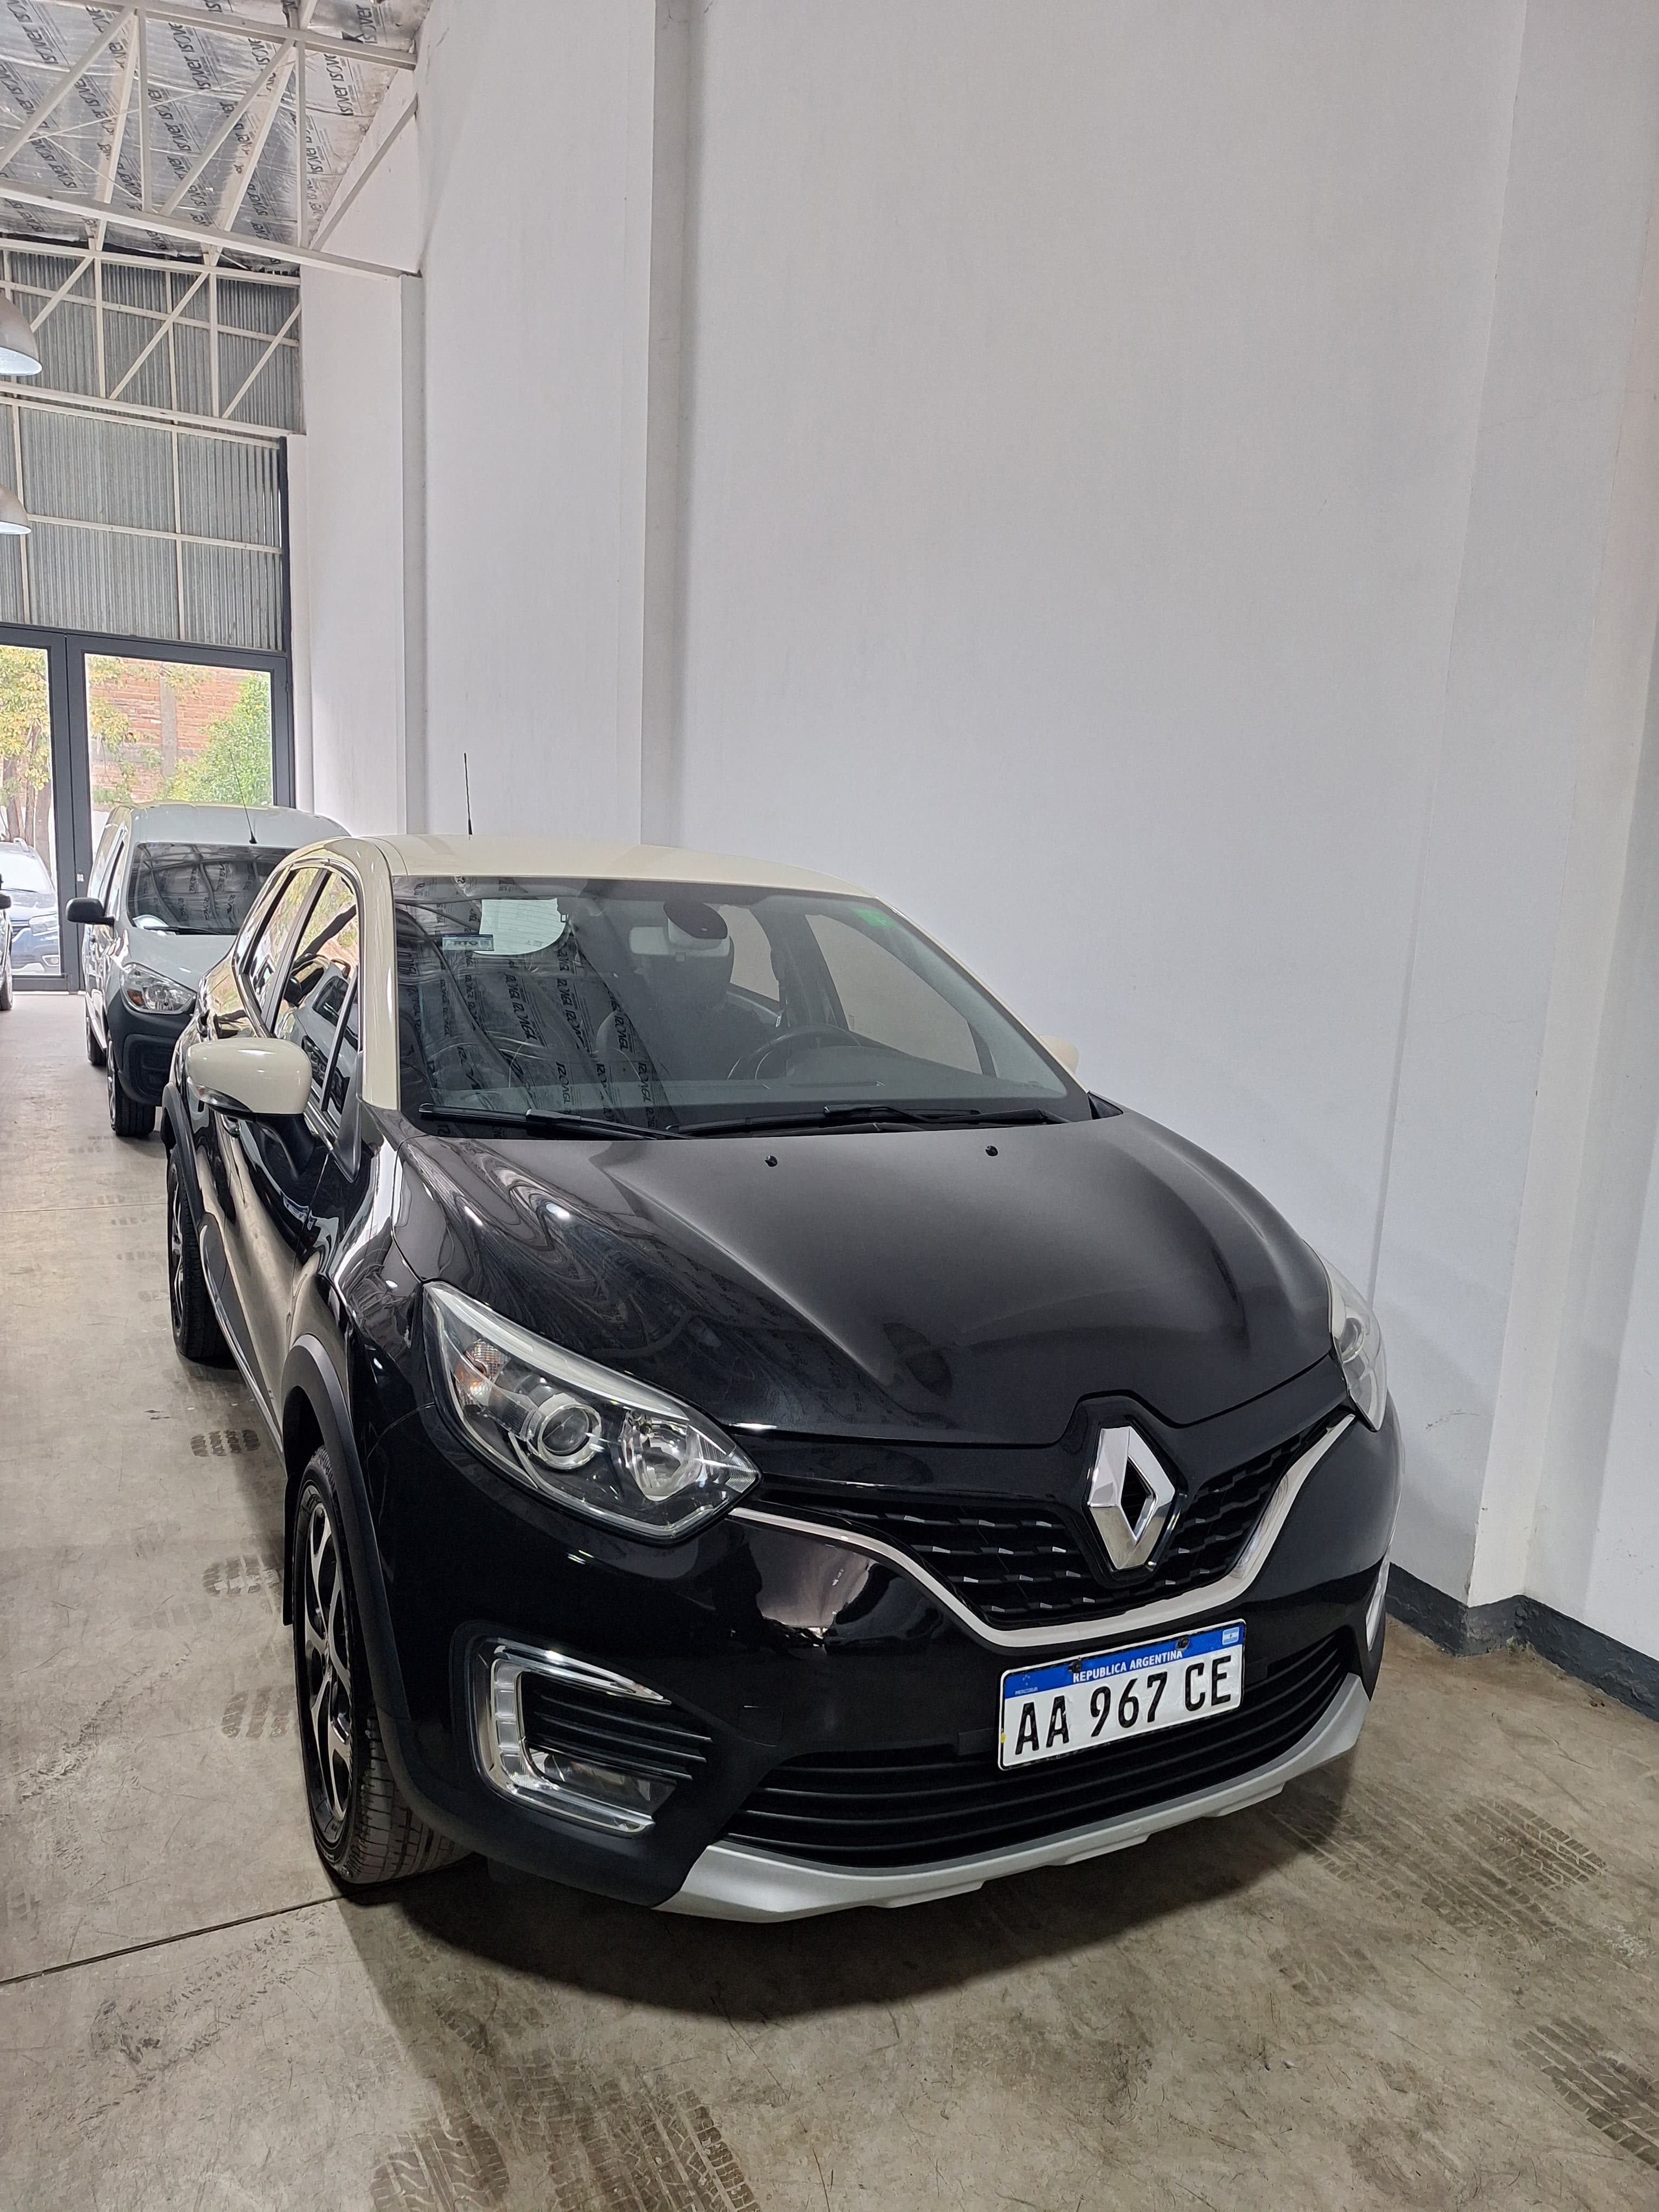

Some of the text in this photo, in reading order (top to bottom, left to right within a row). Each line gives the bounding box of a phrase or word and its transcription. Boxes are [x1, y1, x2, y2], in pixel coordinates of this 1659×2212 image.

[1073, 1649, 1183, 1683] REPUBLICA ARGENTINA
[1015, 1655, 1232, 1755] AA 967 CE
